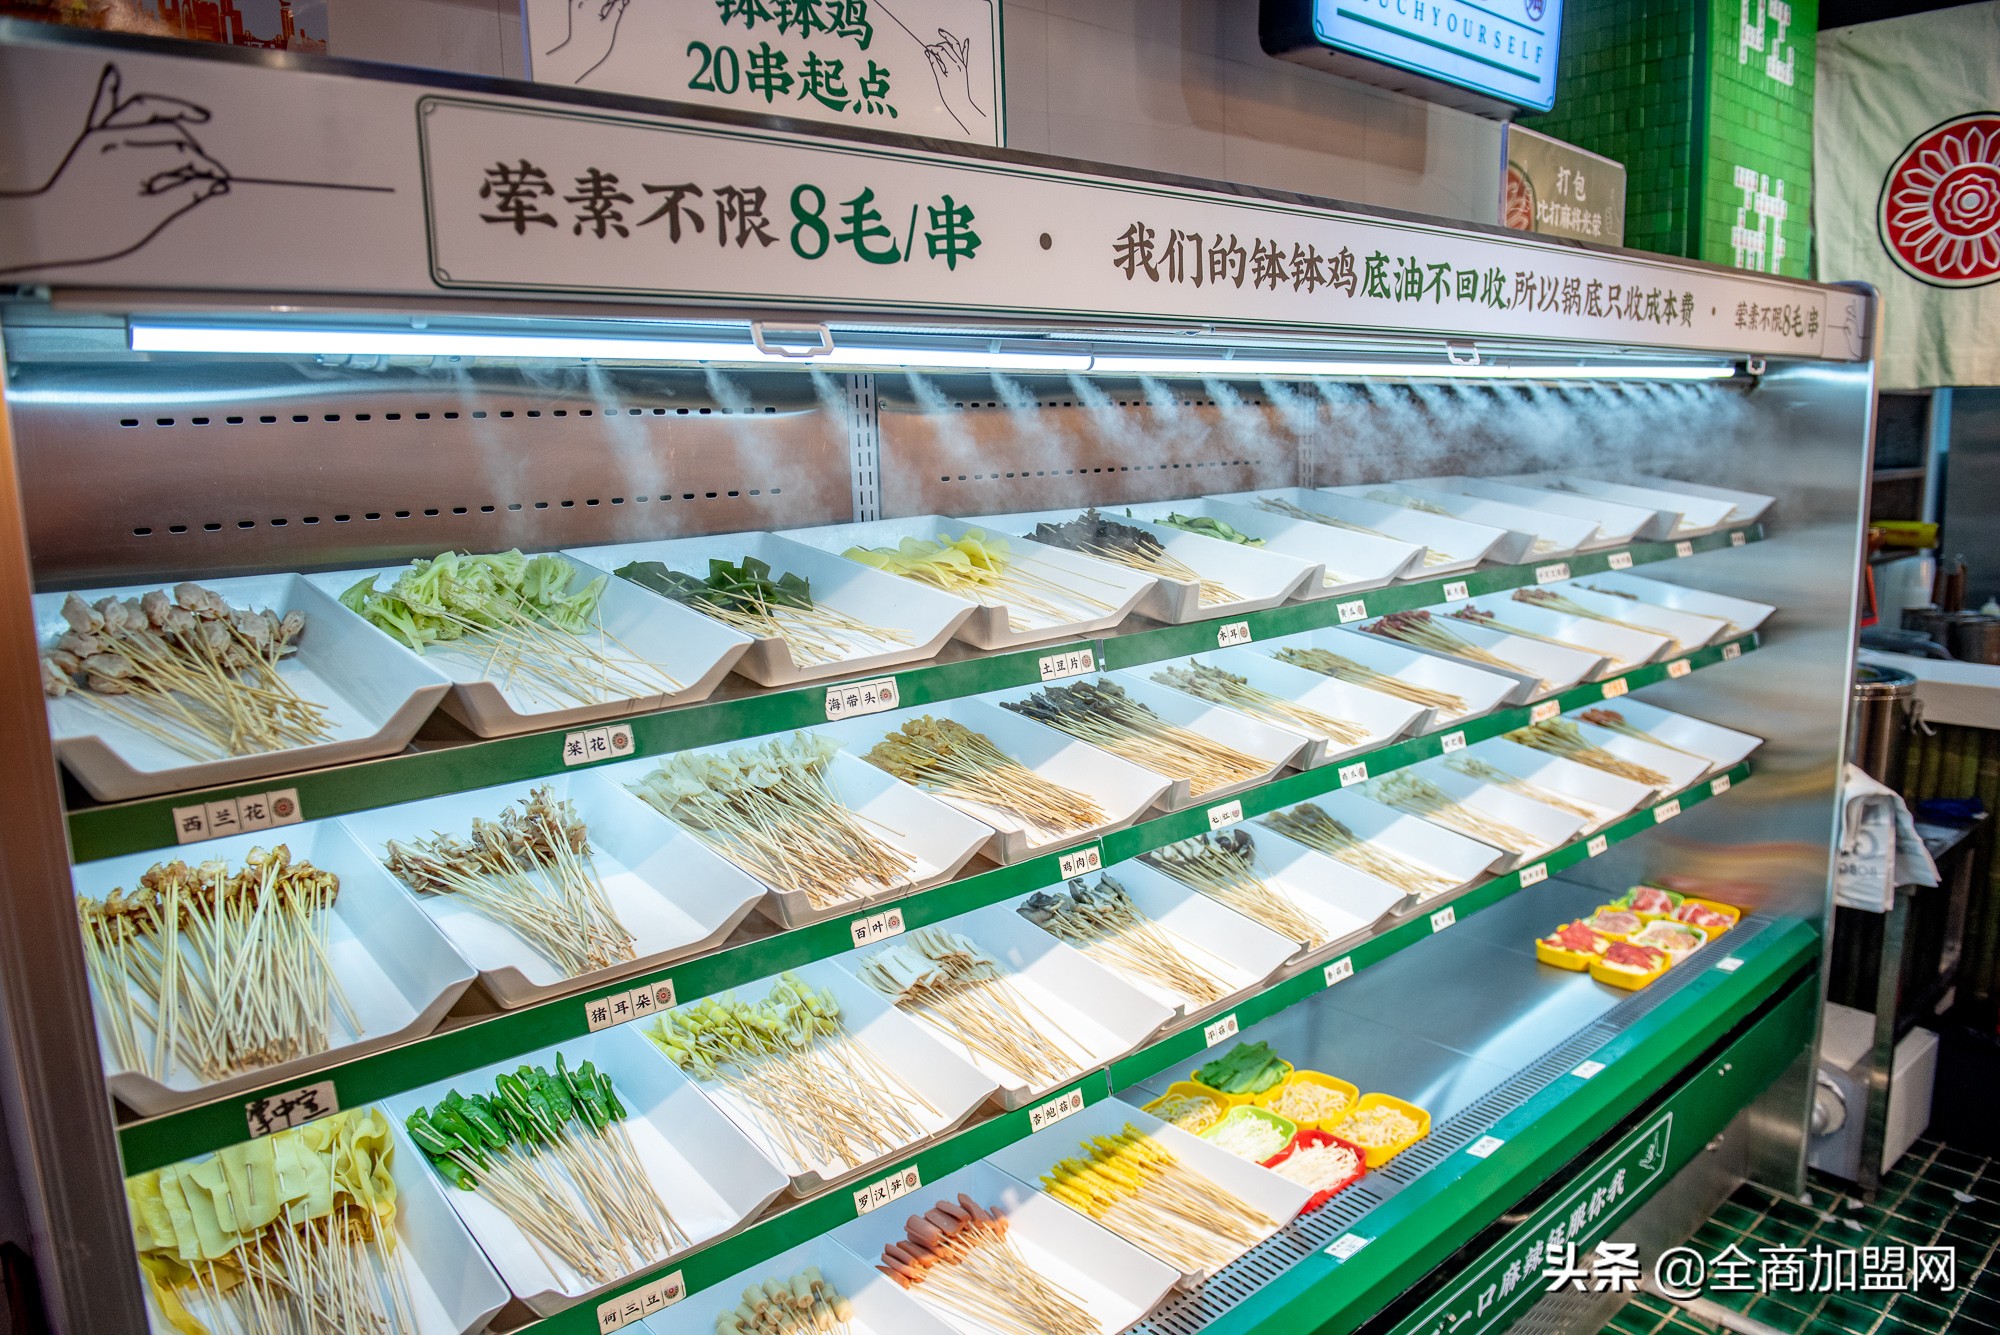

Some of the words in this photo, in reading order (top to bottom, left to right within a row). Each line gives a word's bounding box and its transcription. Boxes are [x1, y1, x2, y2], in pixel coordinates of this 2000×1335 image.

[1363, 0, 1544, 64] UCHYOURSELF
[686, 40, 898, 119] 20串起点
[1555, 165, 1587, 203] 打包
[478, 158, 983, 272] 荤素不限8毛/串
[1042, 656, 1079, 676] 土豆片
[827, 691, 877, 712] 海带头
[566, 736, 607, 757] 菜花
[181, 802, 267, 834] 西兰花
[1062, 857, 1086, 872] 鸡肉
[854, 919, 884, 940] 百叶
[590, 992, 652, 1024] 猪耳朵
[1032, 1099, 1069, 1126] 杏鲍菇
[857, 1178, 903, 1210] 罗汉笋
